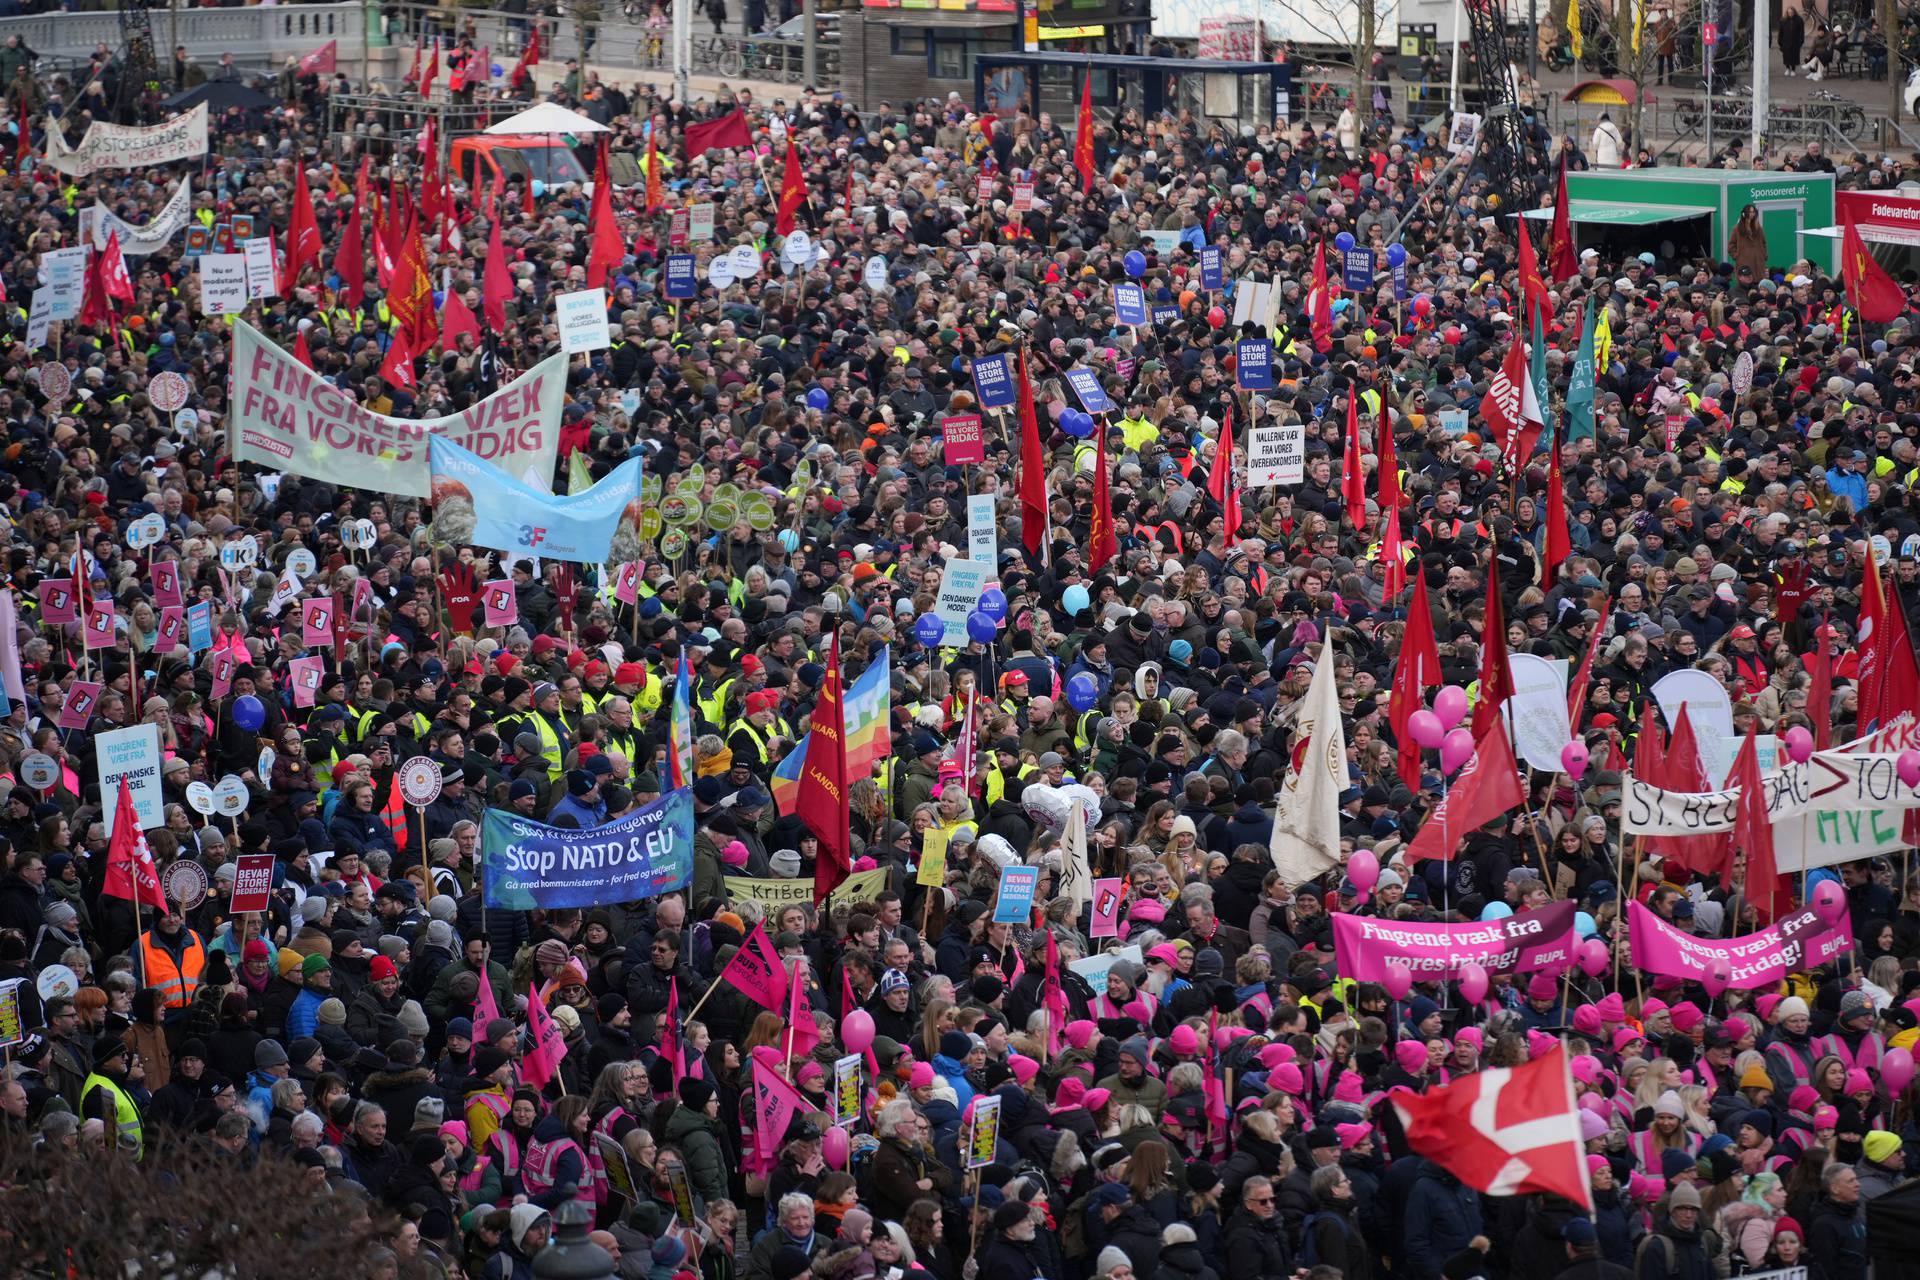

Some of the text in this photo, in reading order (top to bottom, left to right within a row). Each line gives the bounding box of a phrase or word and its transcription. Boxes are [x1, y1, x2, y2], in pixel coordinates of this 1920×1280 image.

[1750, 187, 1796, 199] Sponsoreret
[1872, 203, 1920, 221] Fødevarefor
[1202, 257, 1218, 265] STORE
[1347, 252, 1369, 260] BEVAR
[669, 259, 691, 267] BEVAR
[1347, 259, 1369, 267] STORE
[203, 276, 243, 285] modstand
[219, 287, 239, 298] pligt
[1117, 288, 1138, 297] BEVAR
[566, 298, 595, 310] BEVAR
[1118, 295, 1139, 303] STORE
[209, 302, 224, 312] 3F
[571, 313, 593, 321] VORES
[1154, 310, 1176, 319] BEVAR
[1241, 345, 1266, 354] BEVAR
[1241, 352, 1266, 361] STORE
[976, 359, 1001, 373] BEVAR
[978, 368, 1004, 380] STORE
[1071, 374, 1090, 383] BEVAR
[1075, 379, 1095, 389] STORE
[462, 375, 544, 432] VÆK
[244, 389, 297, 435] FRA
[946, 432, 979, 444] FRIDAG
[1256, 430, 1299, 443] NALLERNE VÆK
[242, 432, 293, 457] ENHEDSLISTEN
[1262, 443, 1293, 455] FRA VORES
[1250, 455, 1302, 469] OVERENSKOMSTER
[518, 525, 547, 547] 3F
[976, 536, 990, 545] MODEL
[223, 549, 246, 563] HK
[951, 571, 980, 581] FINGRENE
[451, 595, 470, 603] FOA
[942, 593, 977, 605] DEN DANSKE
[946, 603, 967, 612] MODEL
[107, 738, 147, 754] FINGRENE
[110, 749, 146, 764] VÆK FRA
[105, 771, 121, 785] DEN
[512, 821, 543, 841] Stop
[505, 827, 673, 877] Stop NATO & EU
[238, 868, 270, 879] BEVAR
[1006, 874, 1032, 885] BEVAR
[237, 877, 269, 888] STORE
[505, 880, 518, 890] Gå
[520, 879, 539, 888] med
[541, 876, 604, 888] kommunisterne
[611, 874, 623, 886] for
[623, 871, 639, 884] fred
[641, 870, 651, 880] og
[235, 887, 267, 896] BEDEDAG
[1003, 884, 1032, 894] STORE
[1361, 918, 1543, 949] Fingrene væk fra
[1731, 932, 1781, 959] væk
[1782, 911, 1817, 933] fra
[1821, 935, 1849, 956] BUPL
[735, 953, 759, 976] BUPL
[1384, 949, 1567, 974] vores fridag! BUPL
